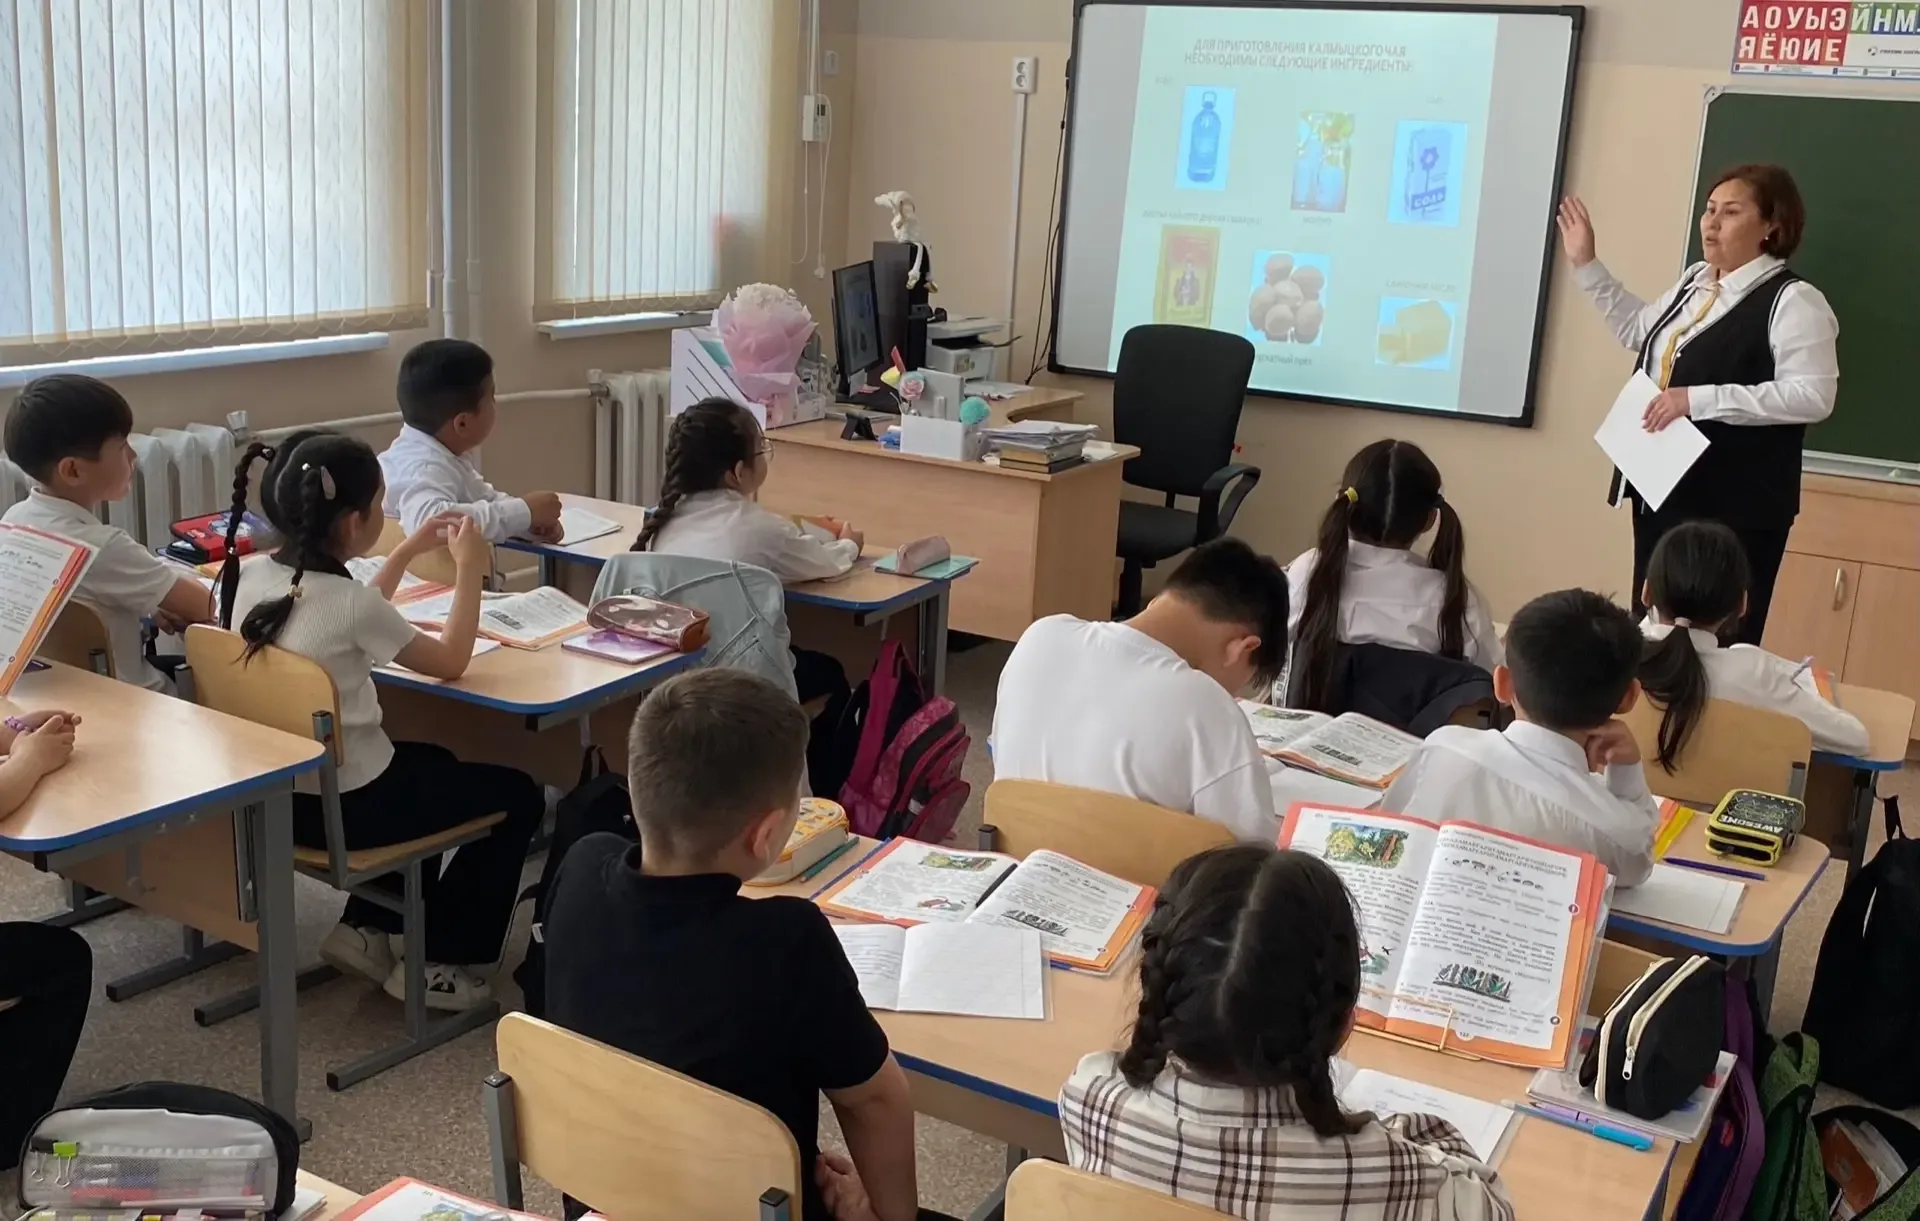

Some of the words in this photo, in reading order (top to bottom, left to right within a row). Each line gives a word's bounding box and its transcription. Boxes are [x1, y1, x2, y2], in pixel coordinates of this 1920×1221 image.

[1216, 39, 1305, 55] ПРИГОТОВЛЕНИЯ
[1185, 52, 1258, 69] НЕОБХОДИМЫ
[1259, 54, 1328, 73] СЛЕДУЮЩИЕ
